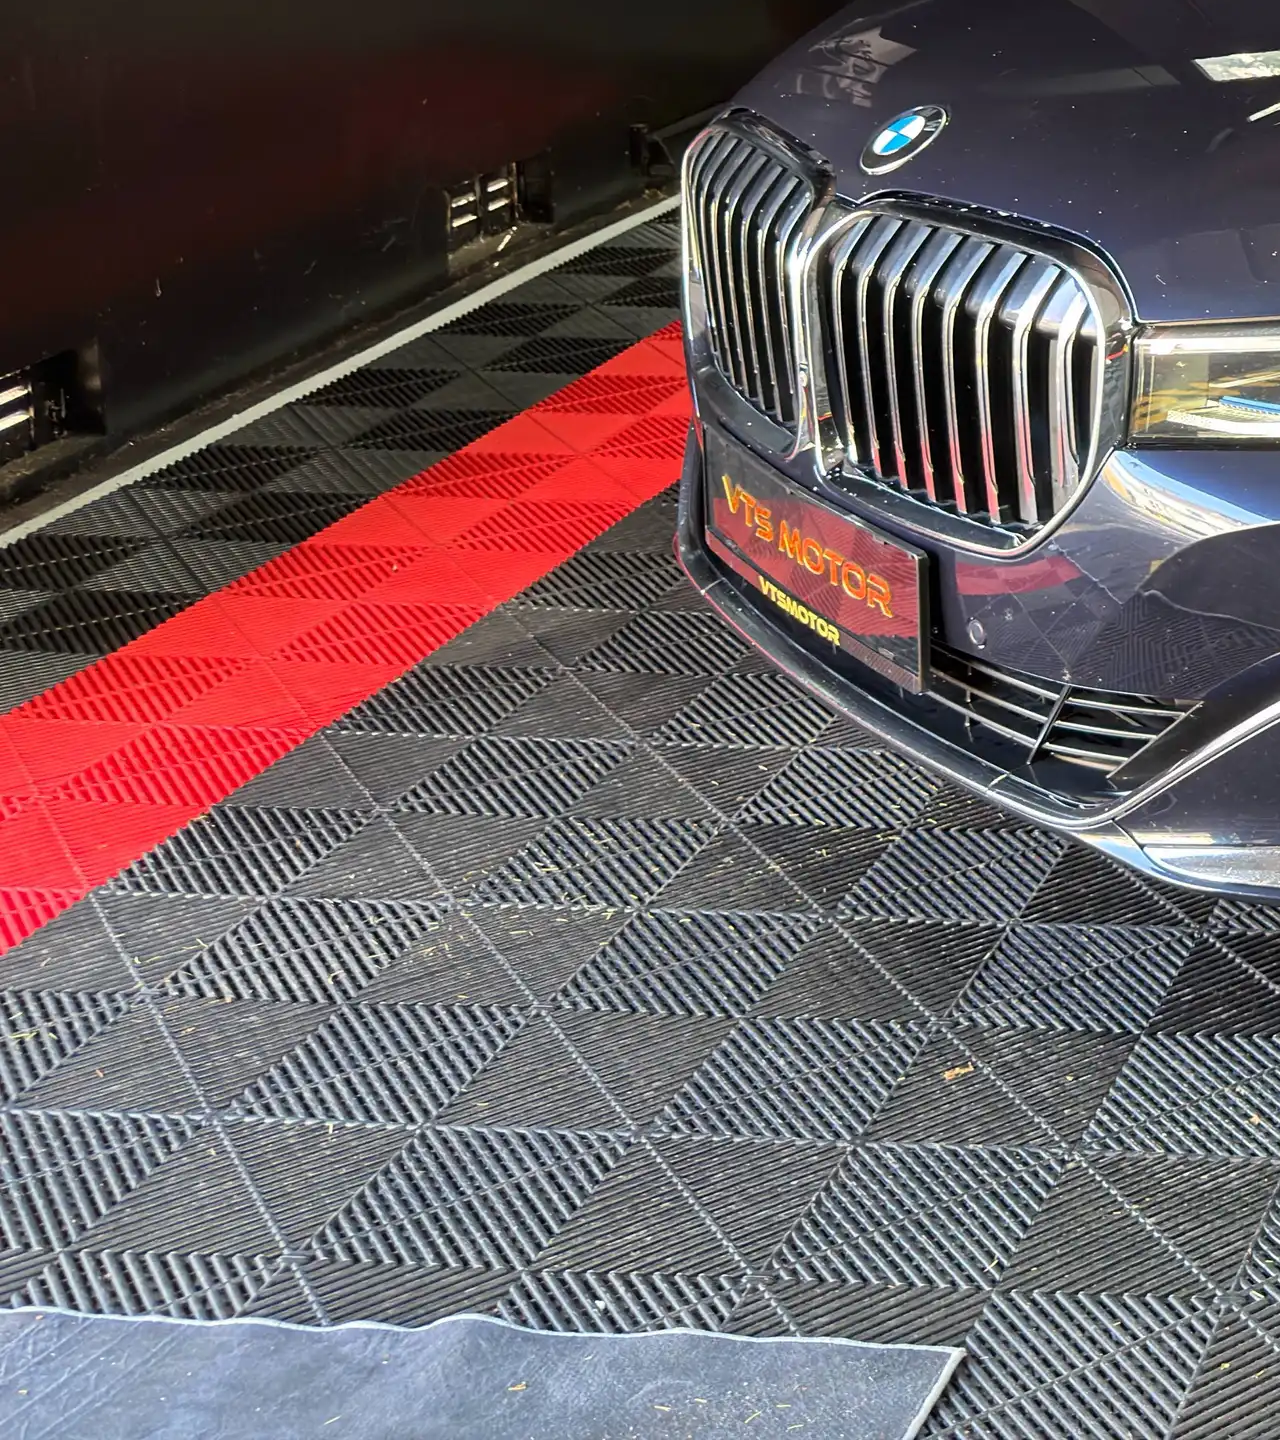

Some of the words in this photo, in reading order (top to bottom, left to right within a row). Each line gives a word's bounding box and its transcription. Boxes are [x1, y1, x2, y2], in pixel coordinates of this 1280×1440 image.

[721, 473, 774, 542] VTS
[778, 519, 893, 619] MOTOR
[758, 574, 841, 647] VTSMOTOR
